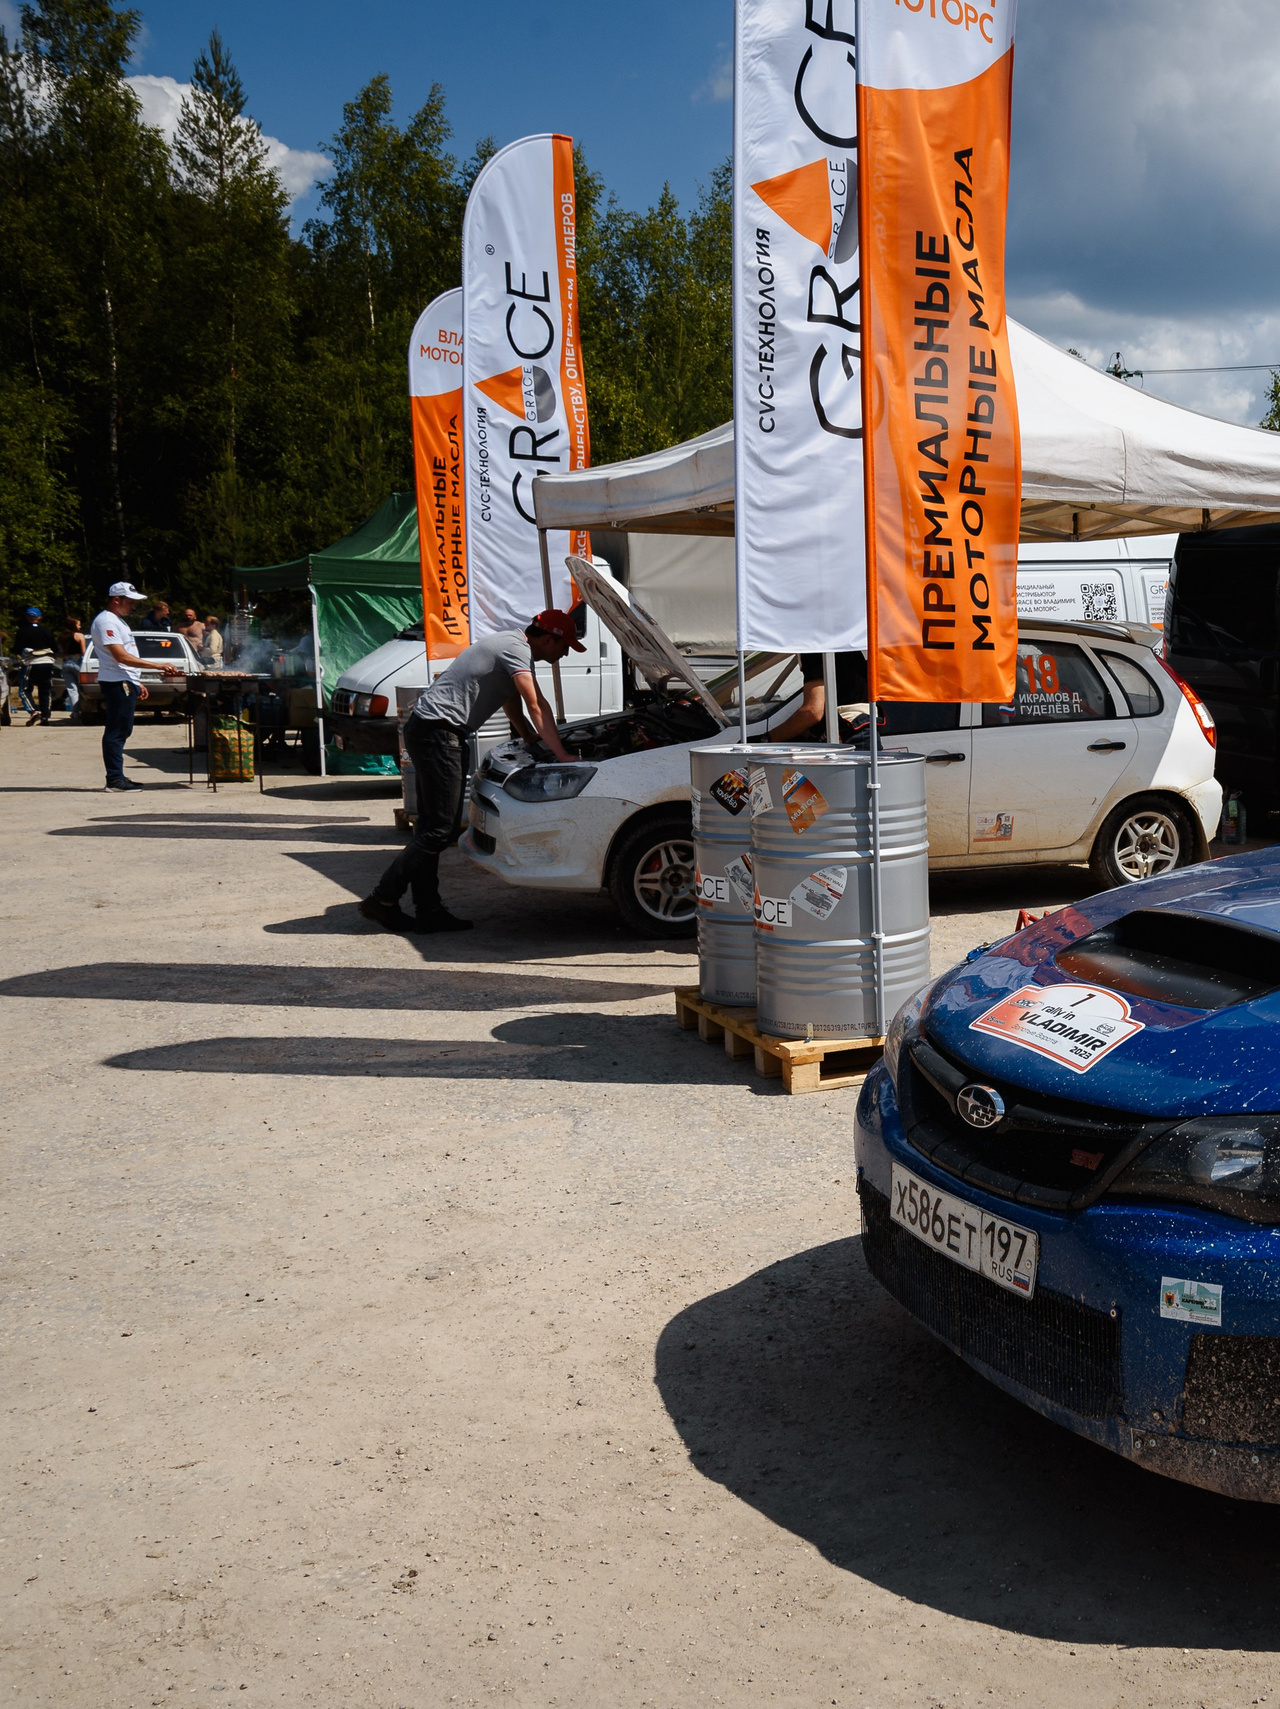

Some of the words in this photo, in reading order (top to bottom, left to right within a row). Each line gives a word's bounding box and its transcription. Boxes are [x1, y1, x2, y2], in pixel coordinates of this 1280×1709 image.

[560, 193, 576, 269] ЛИДЕРОВ
[954, 147, 990, 332] МАСЛА
[522, 366, 536, 422] GRACE
[447, 414, 460, 498] МАСЛА
[914, 230, 956, 650] ПРЕМИАЛЬНЫЕ
[959, 345, 997, 650] МОТОРНЫЕ
[433, 456, 462, 636] ПРЕМИАЛЬНЫЕ
[452, 504, 470, 625] ОТОРНЫЕ
[1016, 583, 1055, 592] ФИЦИАЛЬНЫЙ
[1016, 591, 1057, 599] ИСТРИБЬЮТОР
[1022, 654, 1059, 694] 18
[1019, 692, 1070, 704] ИКРАМОВ
[1072, 692, 1083, 704] Д.
[1020, 702, 1071, 716] ГУДЕЛЁВ
[1073, 703, 1084, 713] П.
[818, 872, 832, 882] GREAT
[832, 878, 844, 889] WALL
[1018, 1011, 1107, 1052] VLADIMIR
[1041, 1005, 1066, 1018] rally
[1063, 1011, 1076, 1021] in
[1069, 1045, 1093, 1060] 2023
[984, 1220, 1028, 1270] 197
[991, 1261, 1014, 1283] RUS
